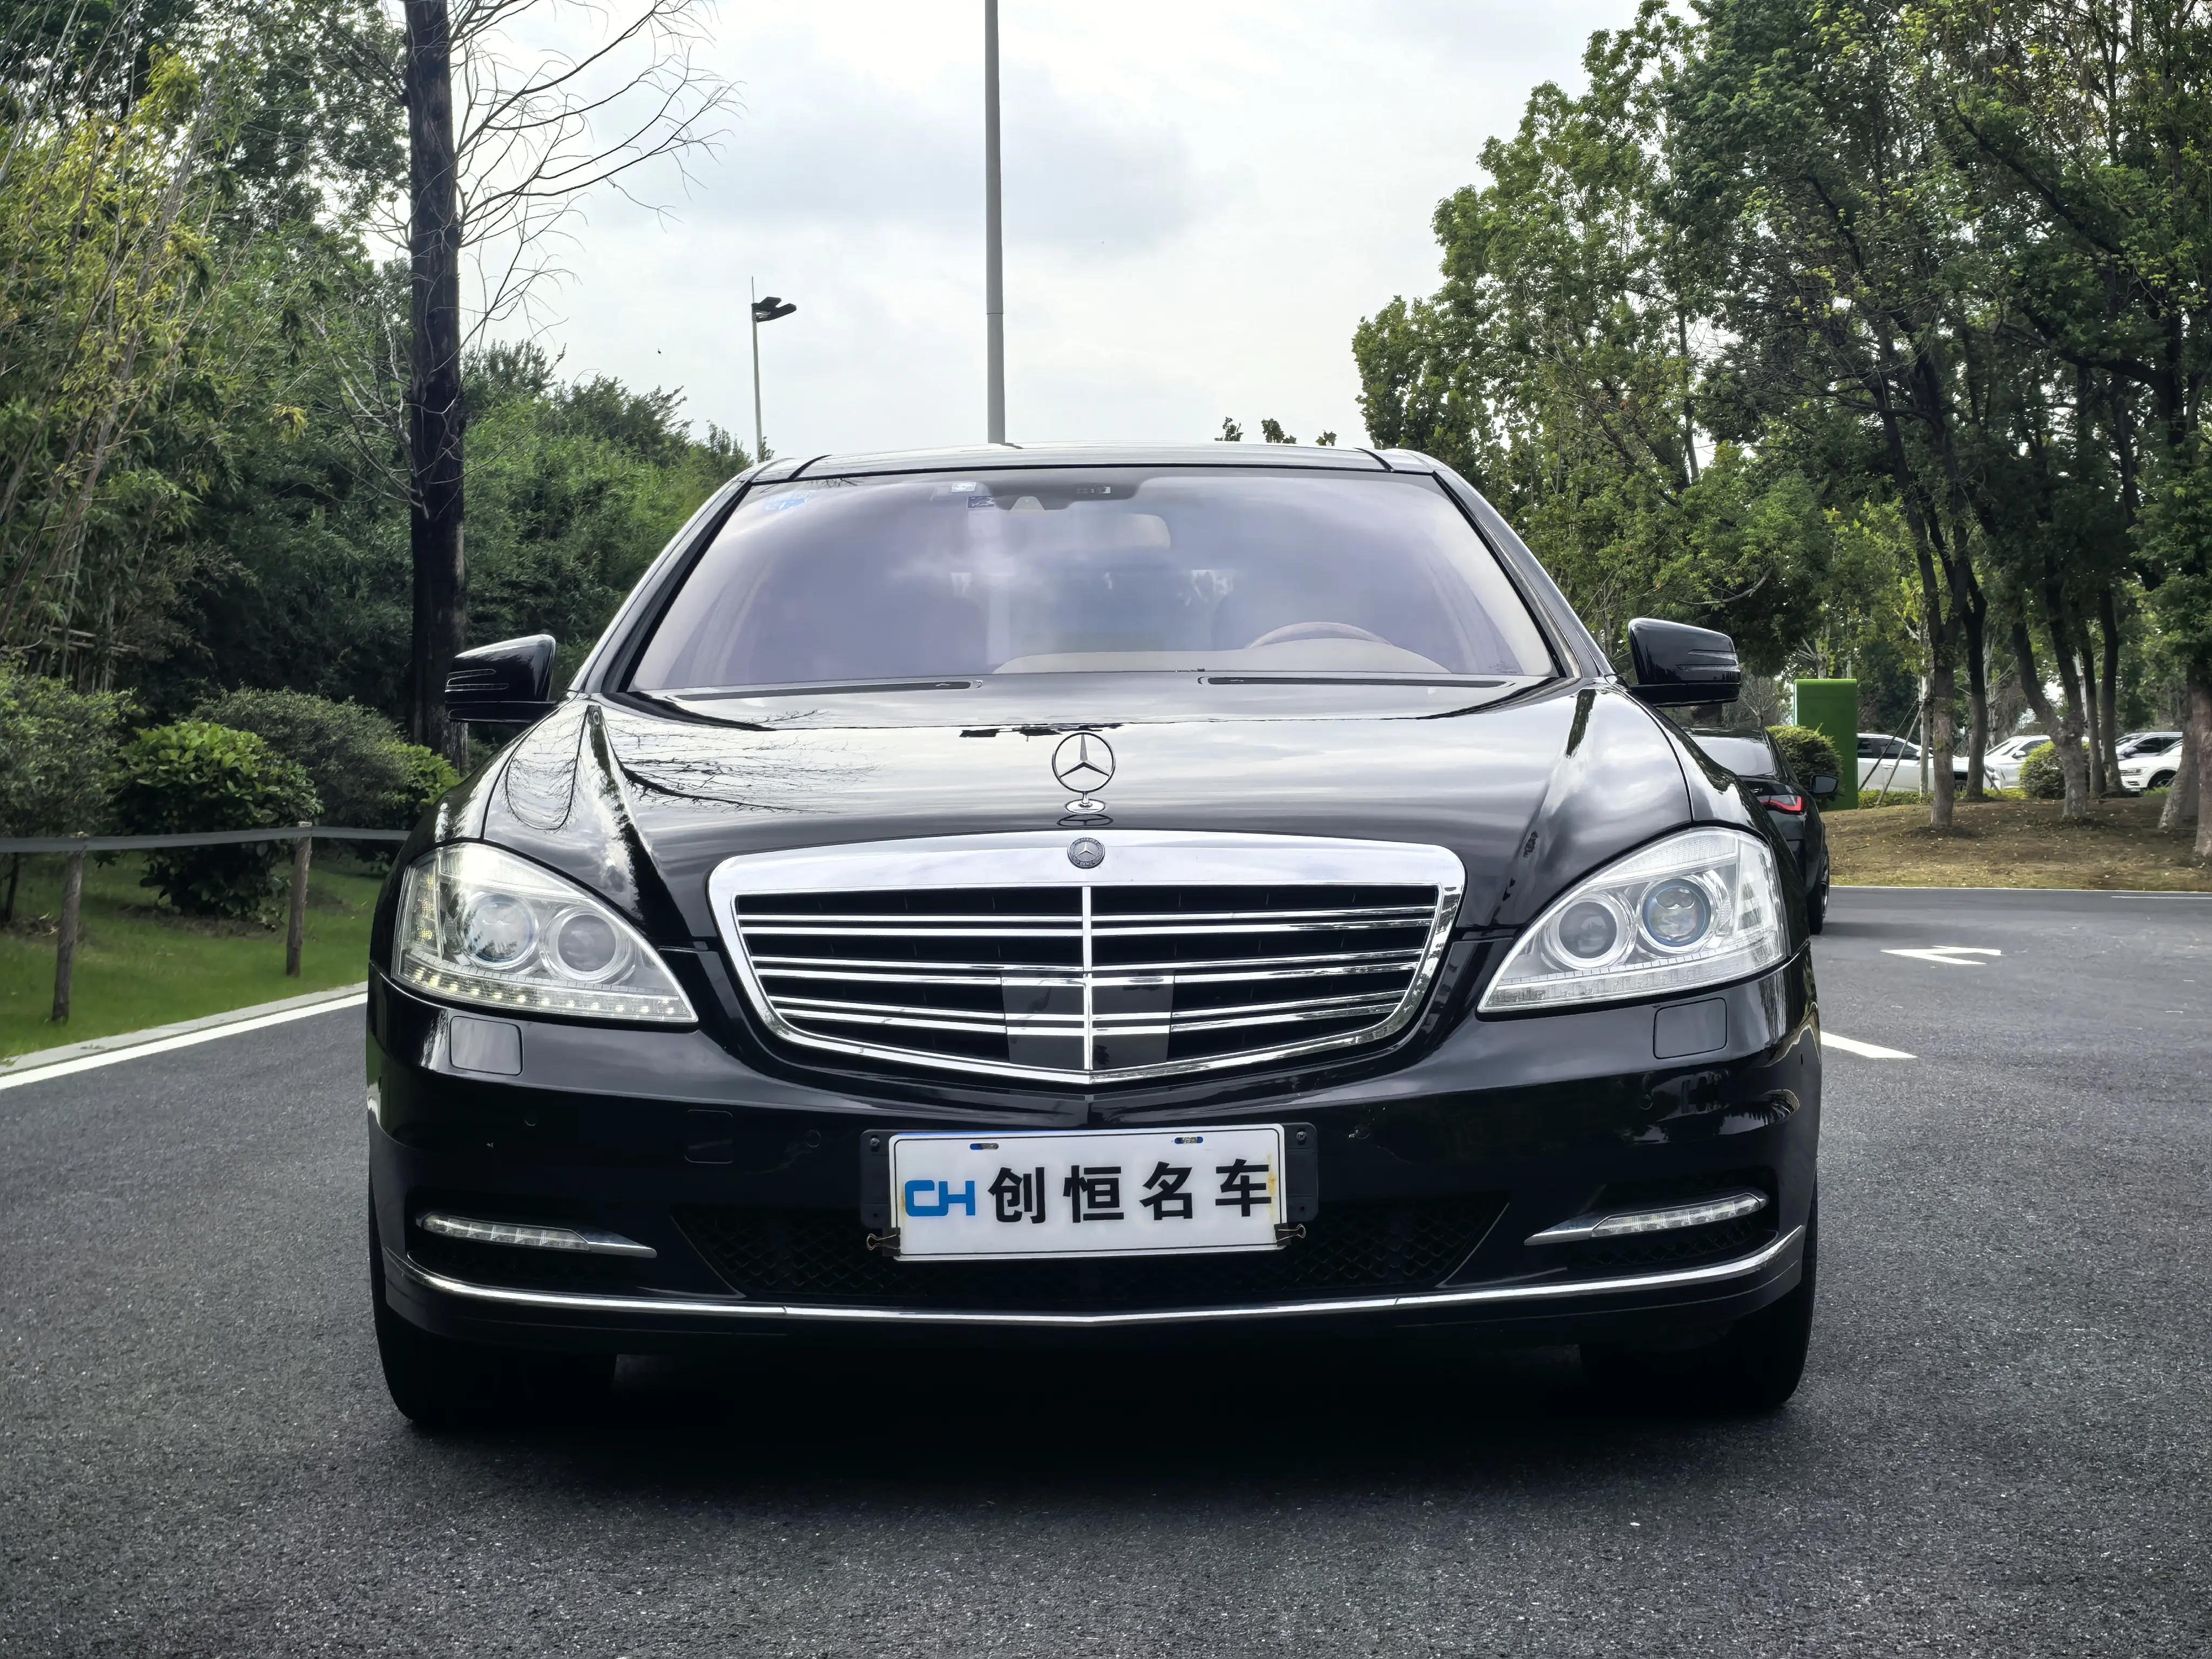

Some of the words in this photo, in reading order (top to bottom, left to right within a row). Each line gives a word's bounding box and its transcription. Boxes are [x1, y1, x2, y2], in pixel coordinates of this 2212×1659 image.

[905, 1179, 976, 1217] CH
[988, 1158, 1272, 1224] 创恒名车
